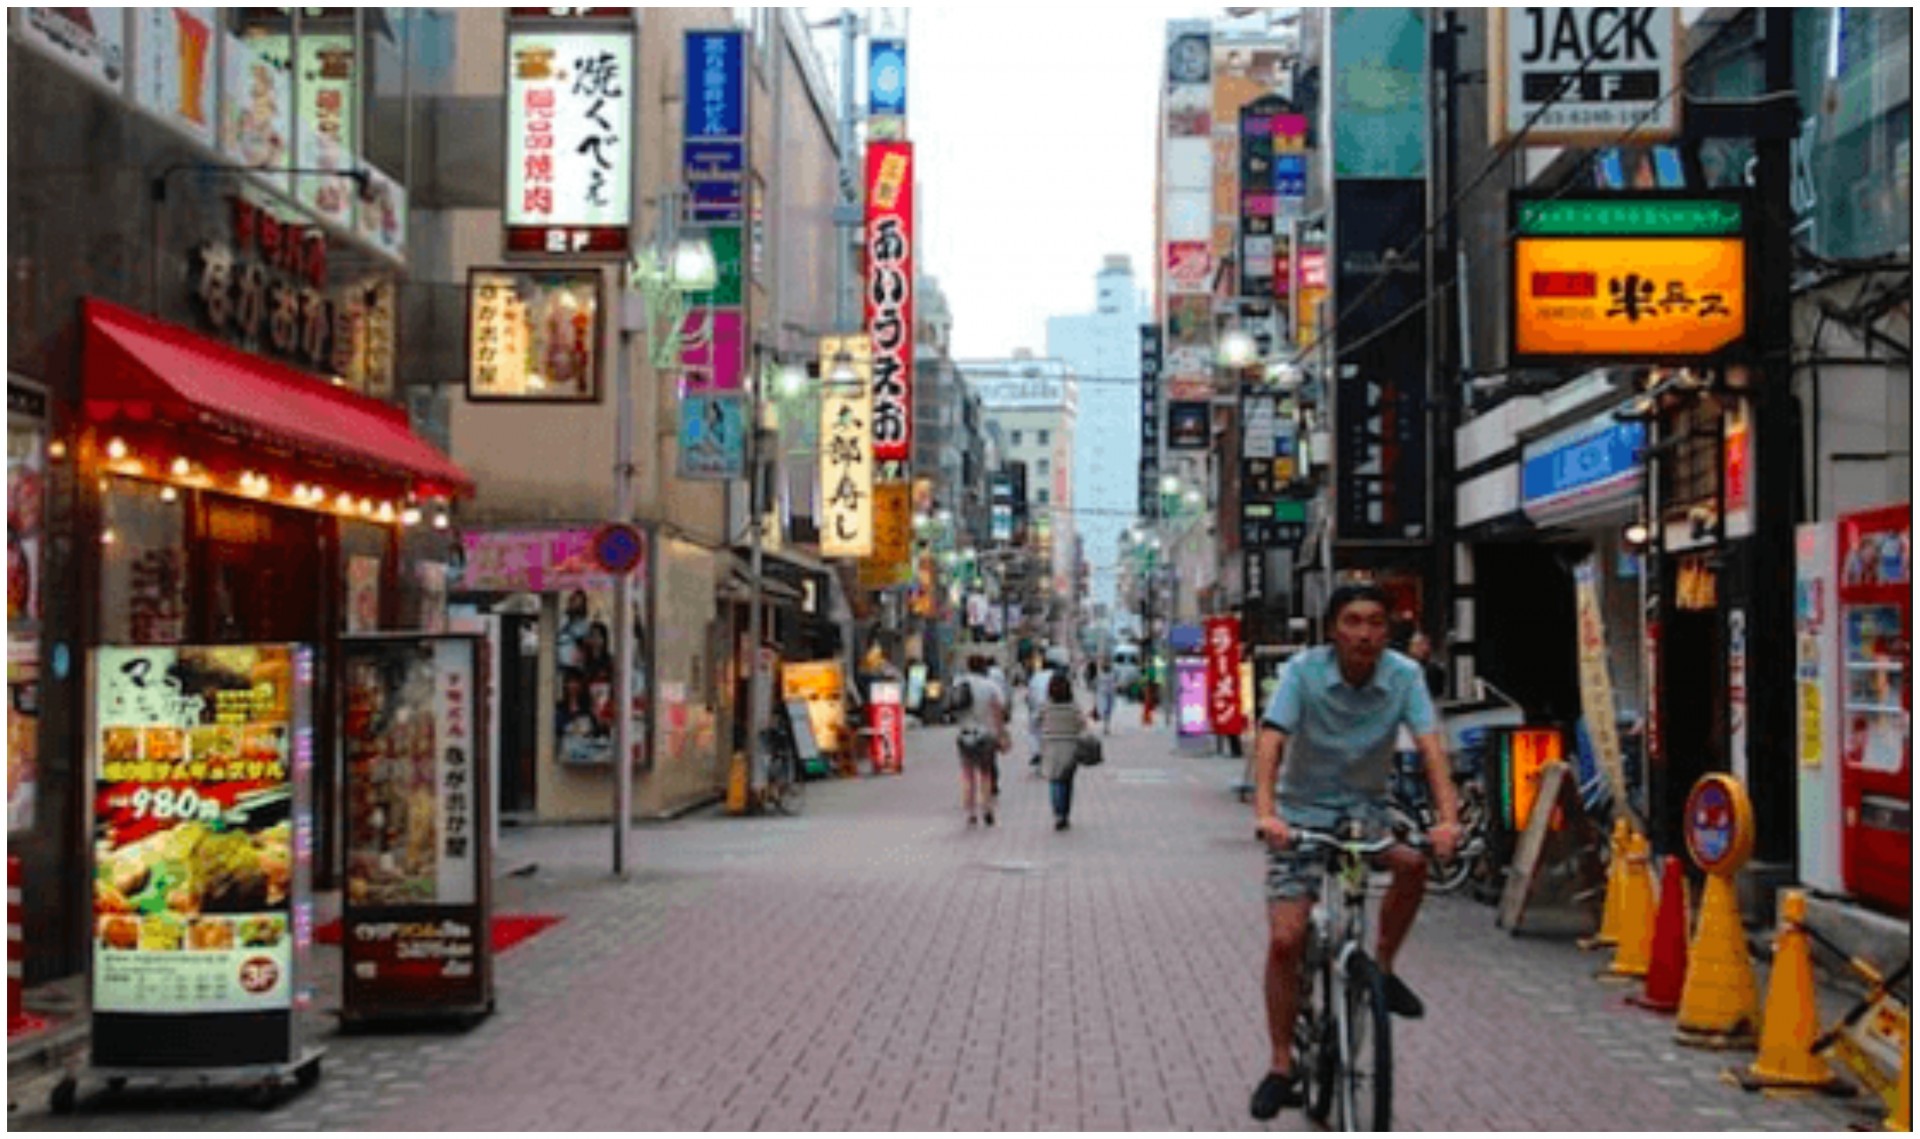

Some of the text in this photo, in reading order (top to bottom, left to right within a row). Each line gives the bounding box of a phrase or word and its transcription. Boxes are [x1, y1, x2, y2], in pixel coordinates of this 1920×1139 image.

[1520, 7, 1658, 62] JACK
[546, 231, 591, 252] 2F
[872, 217, 904, 442] あいうえお
[829, 405, 865, 541] 太郎寿し
[1211, 626, 1237, 725] ラーメン
[242, 964, 277, 988] 3F
